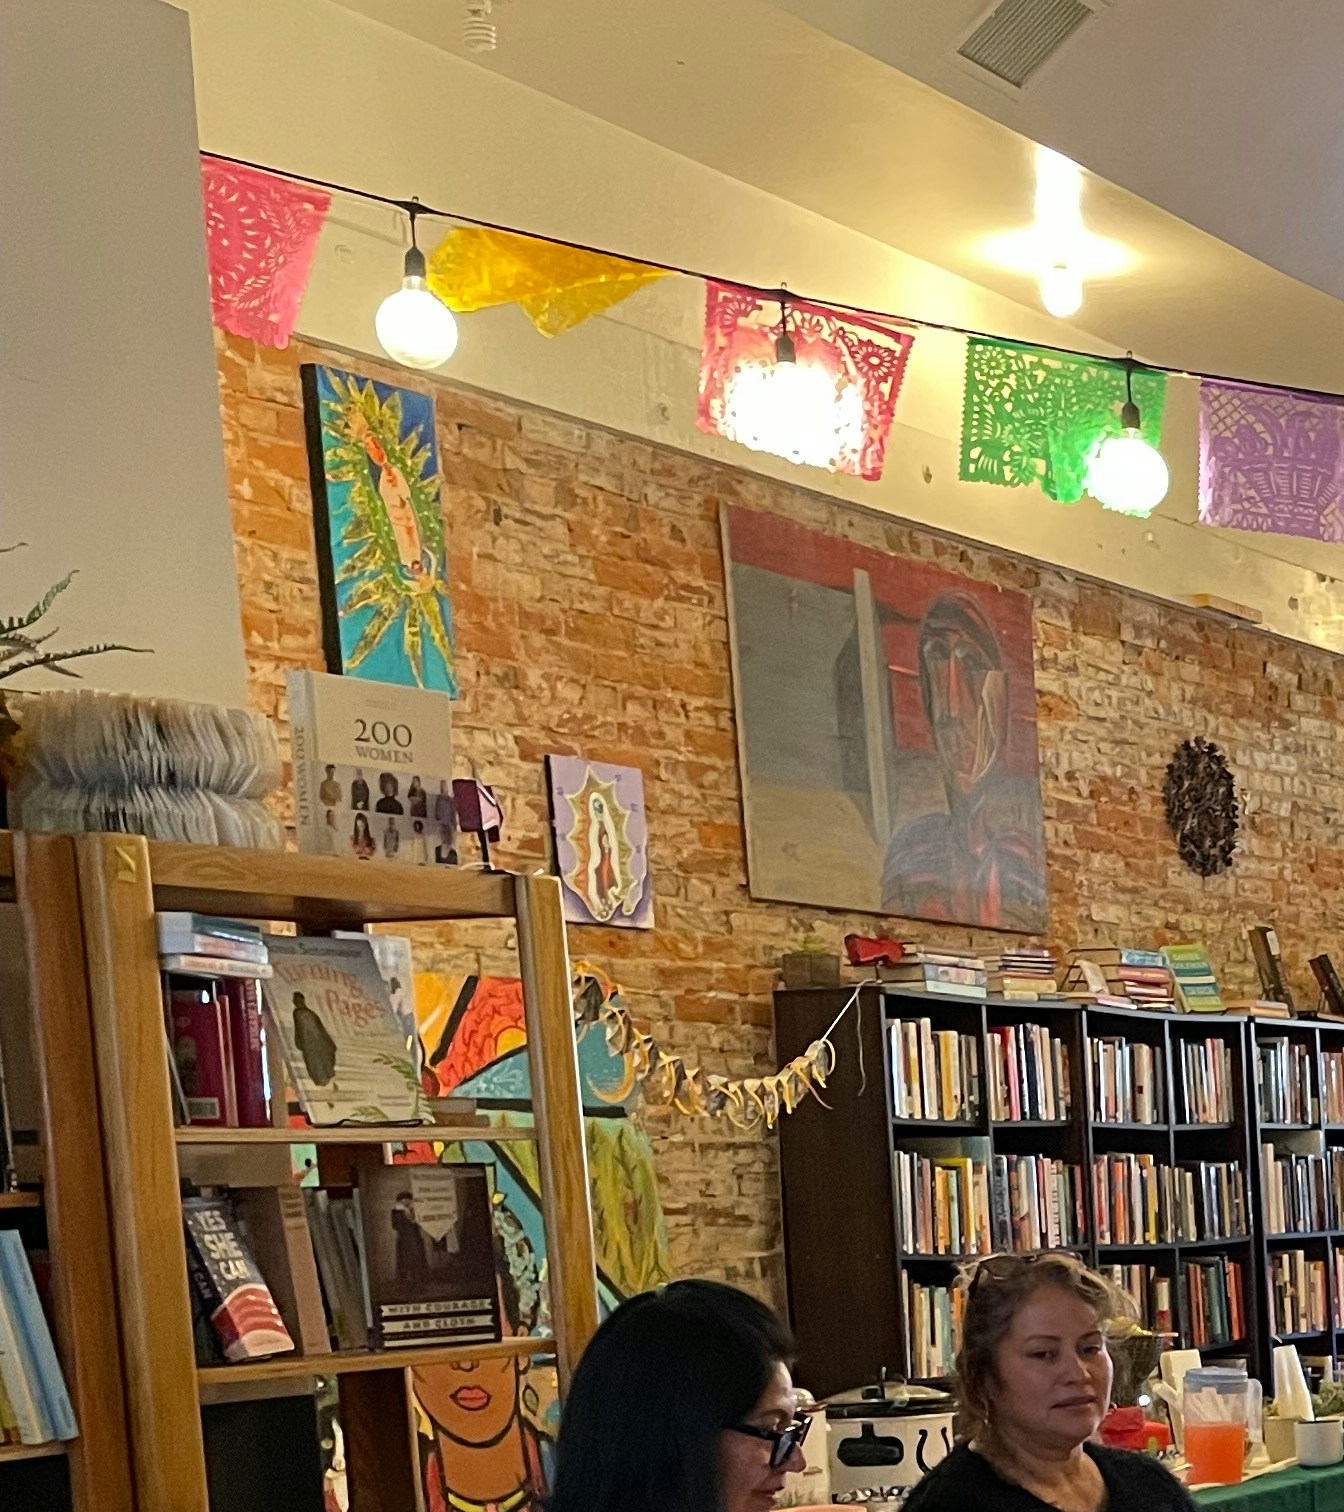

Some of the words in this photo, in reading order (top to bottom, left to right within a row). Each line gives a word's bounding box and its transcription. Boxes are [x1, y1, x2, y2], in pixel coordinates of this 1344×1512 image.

[354, 719, 412, 748] 200
[355, 746, 414, 764] WOMEN
[195, 1210, 227, 1231] YES
[204, 1232, 243, 1260] SHE
[220, 1260, 250, 1280] CAN
[388, 1304, 421, 1314] WITH
[426, 1300, 486, 1312] COURAGE
[402, 1320, 430, 1330] AND
[434, 1317, 477, 1329] CLOTH
